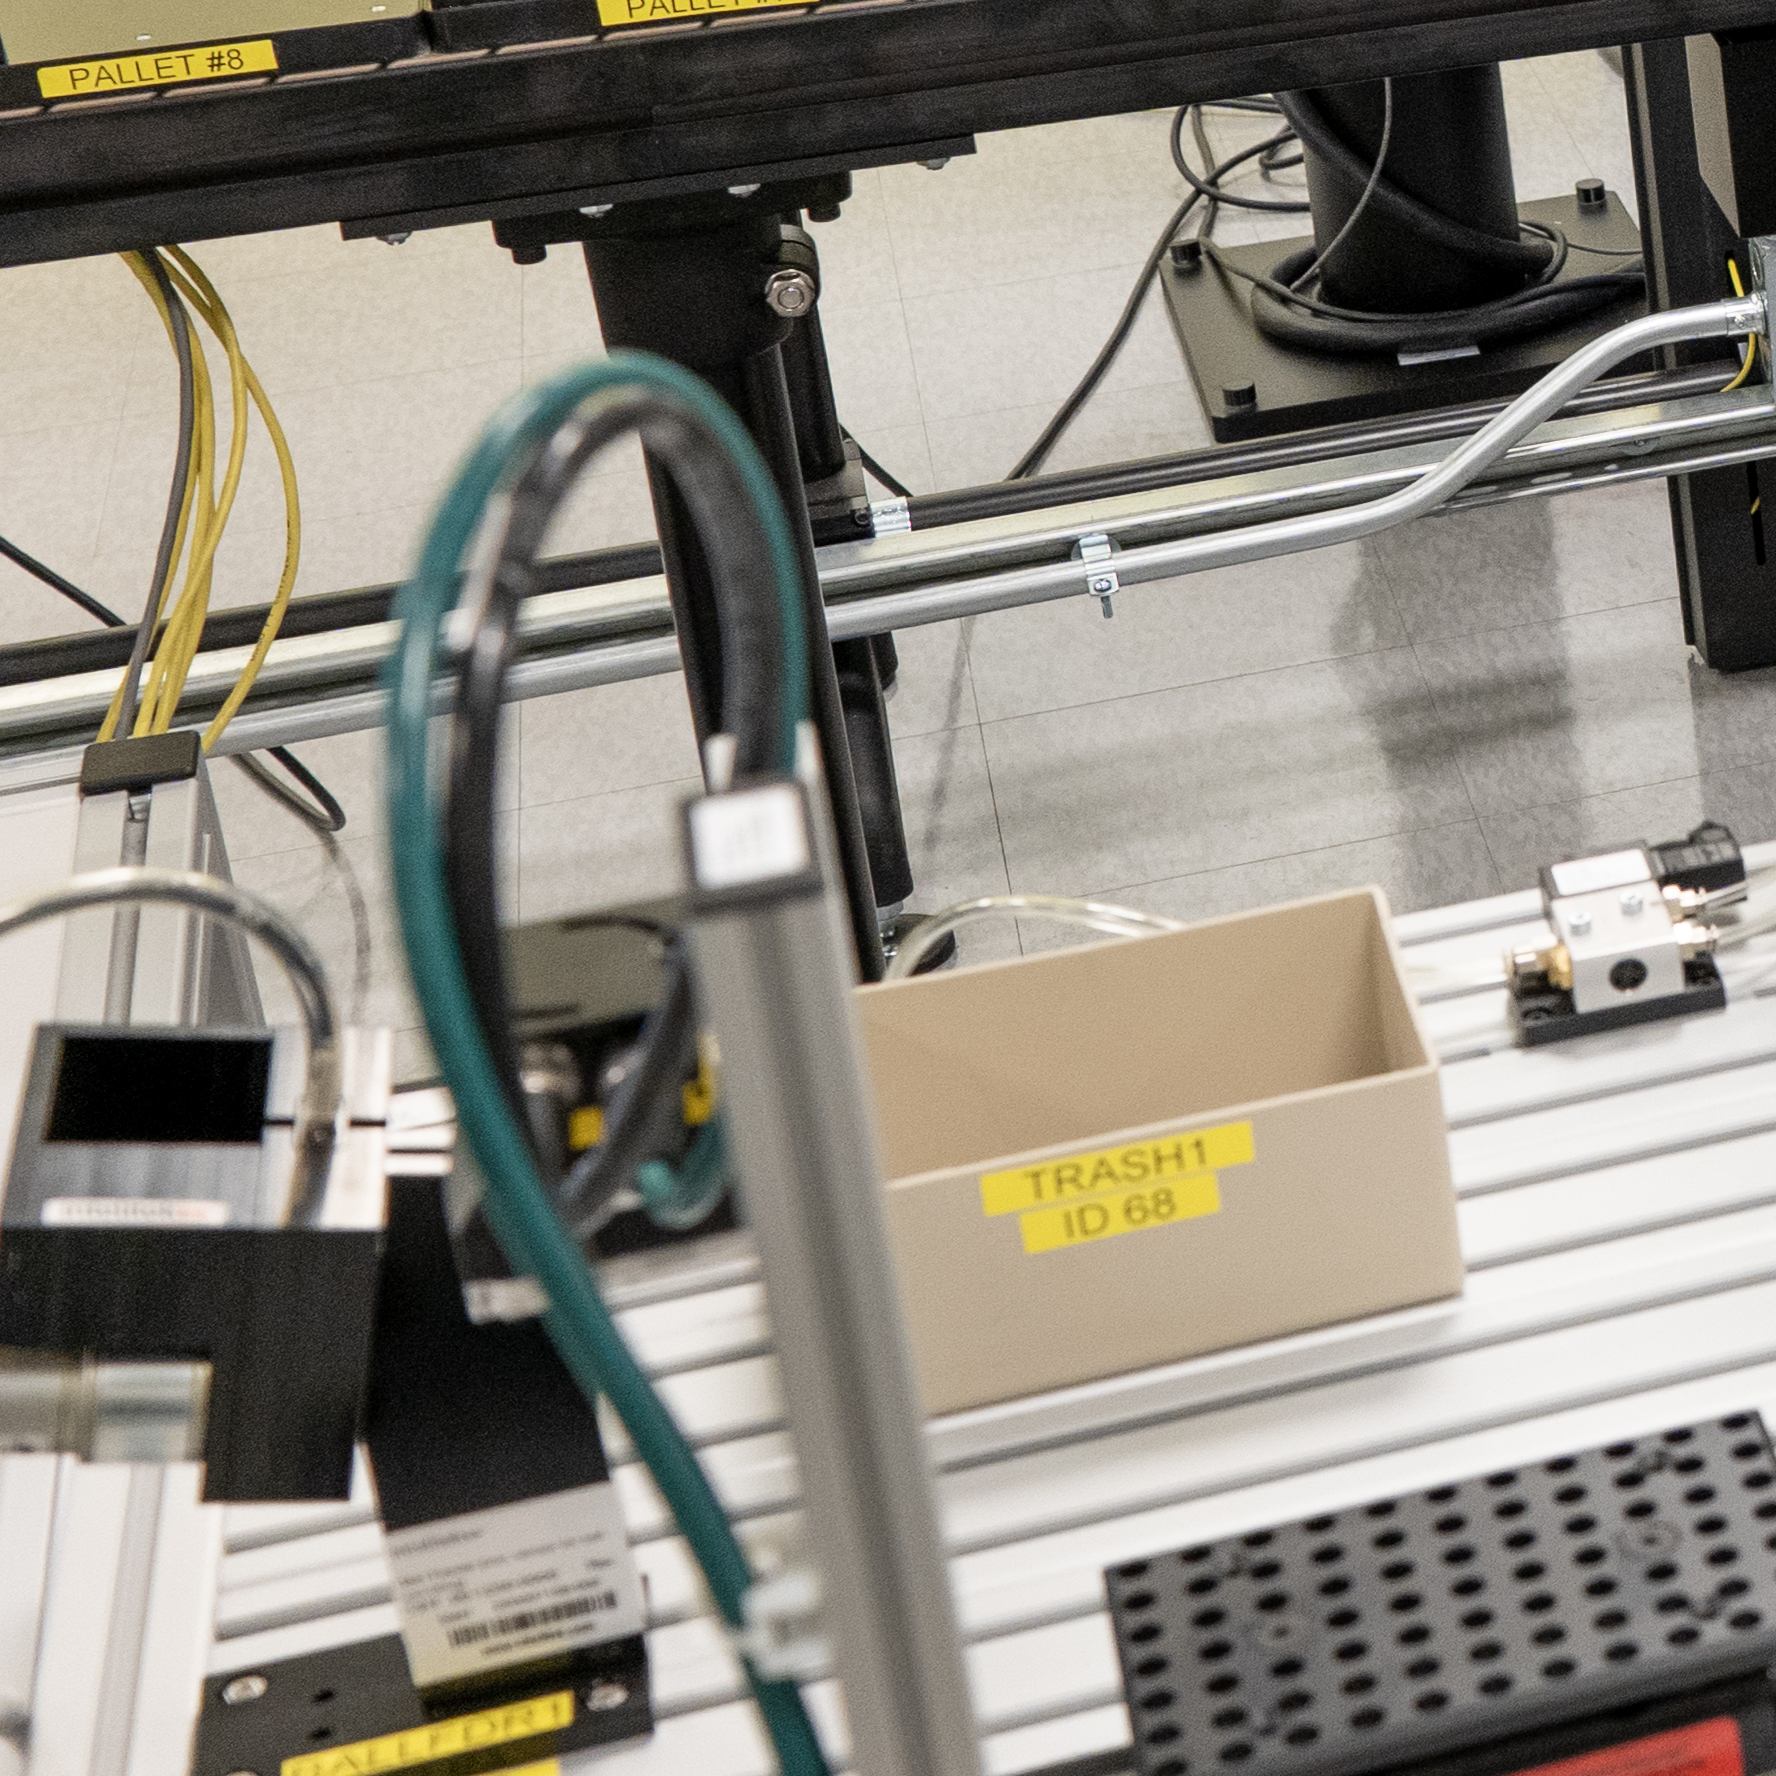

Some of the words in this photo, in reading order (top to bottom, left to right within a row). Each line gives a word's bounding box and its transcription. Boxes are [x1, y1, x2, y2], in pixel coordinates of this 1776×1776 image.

[68, 54, 195, 91] PALLET
[205, 49, 244, 72] #8
[1024, 1138, 1207, 1201] TRASH1
[1062, 1204, 1110, 1239] ID
[1123, 1187, 1178, 1226] 68
